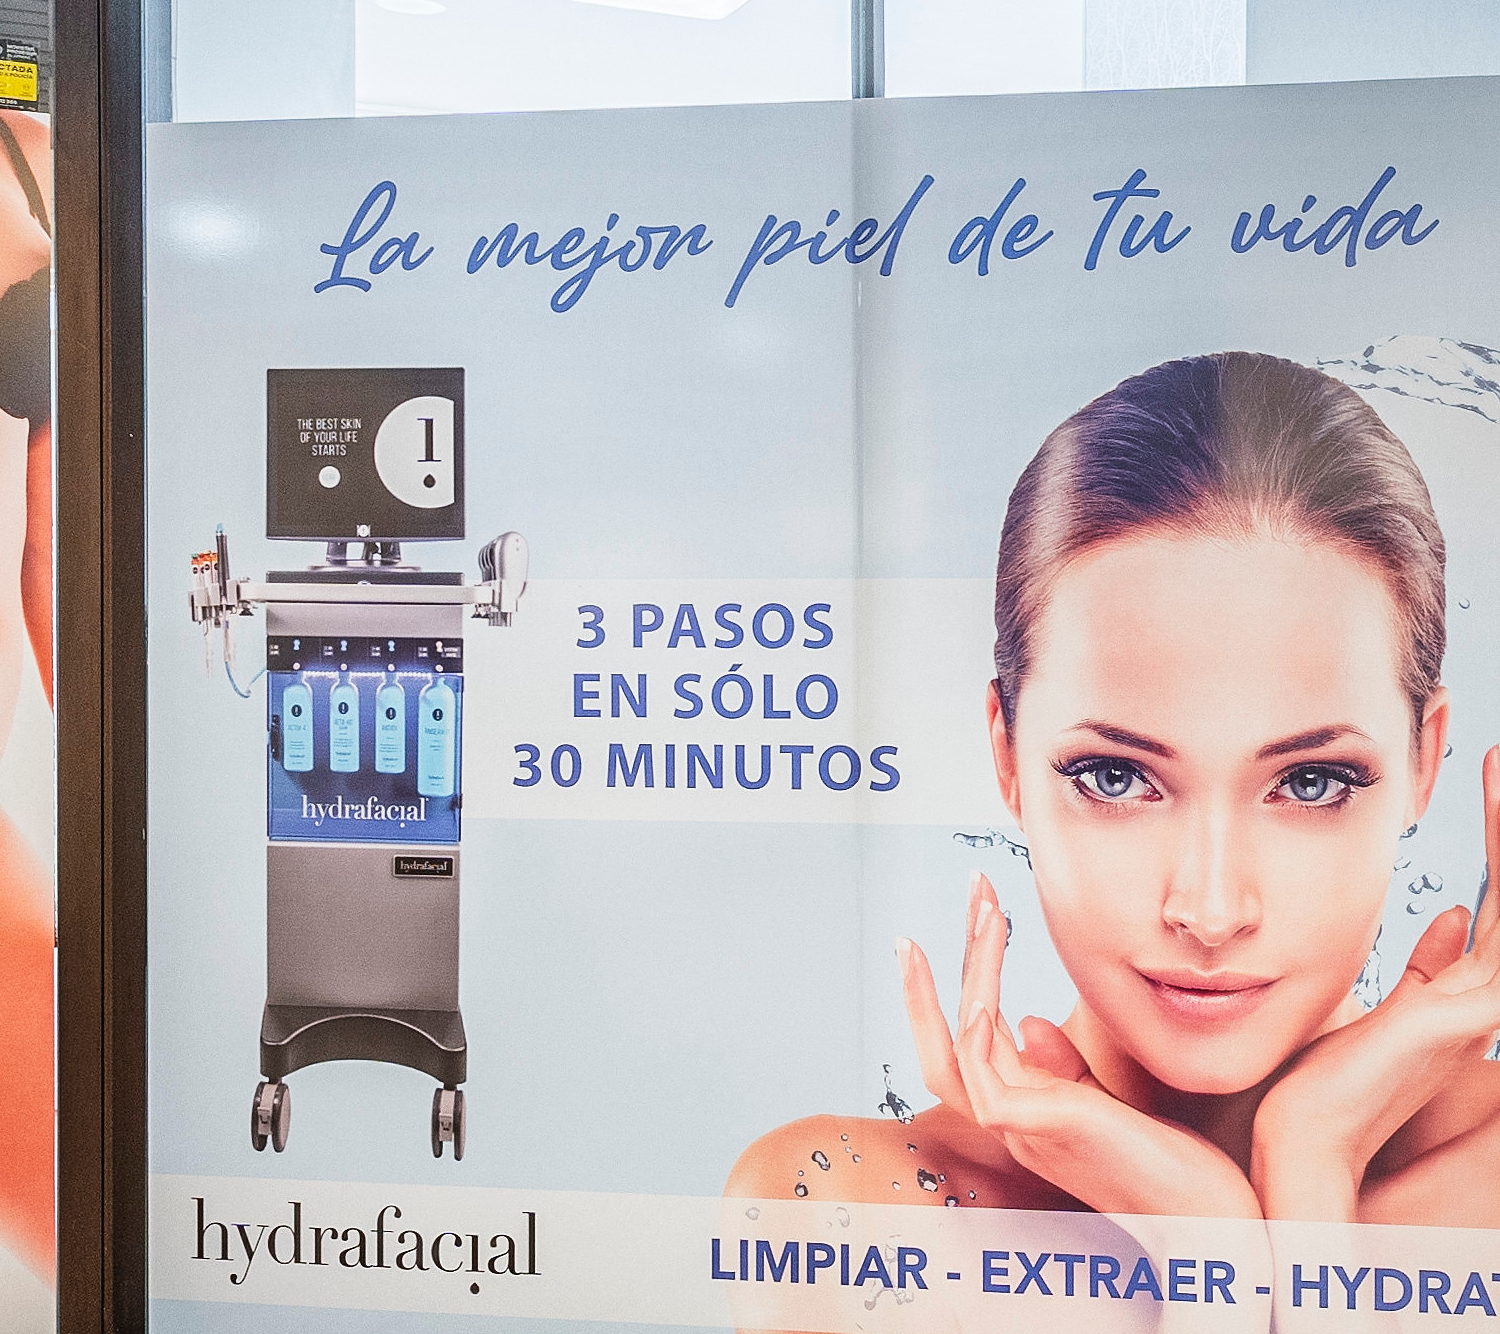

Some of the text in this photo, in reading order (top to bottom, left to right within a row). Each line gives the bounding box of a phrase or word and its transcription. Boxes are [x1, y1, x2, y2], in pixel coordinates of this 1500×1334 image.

[313, 166, 1440, 313] La mejor piel de tu vida
[297, 418, 361, 430] THE BEST SKIN
[300, 431, 357, 443] OF YOUR LIFE
[312, 445, 346, 456] STARTS
[576, 603, 833, 649] 3 PASOS
[573, 663, 838, 720] EN SÓLO
[513, 743, 900, 792] 30 MINUTOS
[301, 795, 426, 827] hydrafacial
[191, 1197, 542, 1295] hydrafacial
[711, 1238, 929, 1296] LIMPIAR
[982, 1250, 1236, 1312] EXTRAER
